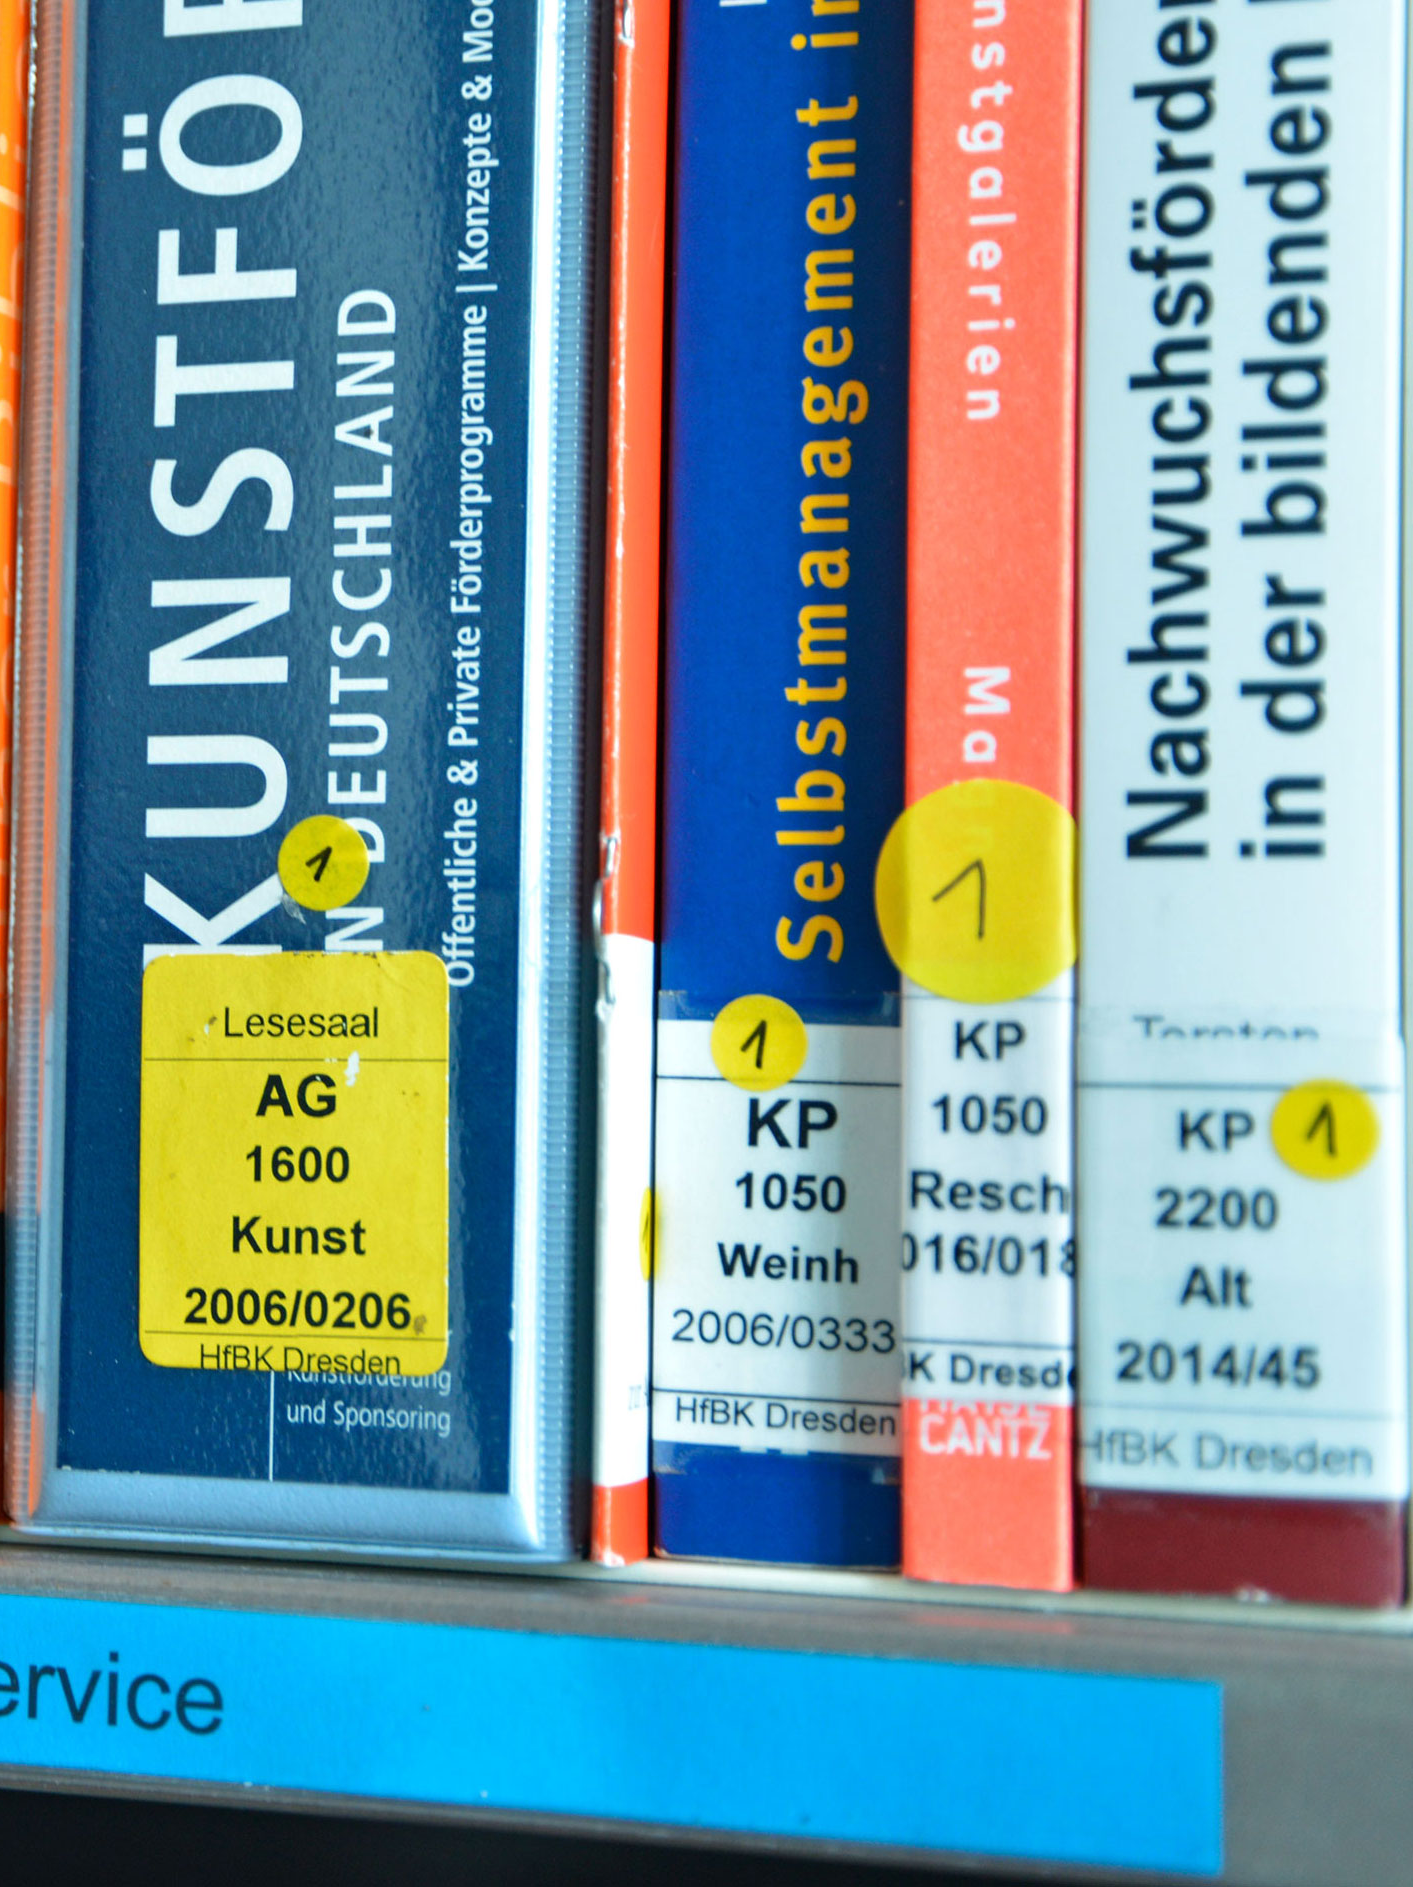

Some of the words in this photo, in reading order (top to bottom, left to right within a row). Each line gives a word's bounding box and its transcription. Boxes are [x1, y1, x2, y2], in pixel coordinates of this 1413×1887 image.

[461, 74, 493, 101] &
[457, 112, 498, 272] Konzepte
[1240, 39, 1333, 537] bildenden
[449, 305, 493, 614] Förderprogramme
[122, 0, 303, 968] KUNSTFÖ
[774, 95, 869, 964] Selbstmanagement
[1239, 572, 1327, 735] der
[447, 624, 482, 747] Private
[447, 759, 479, 786] &
[1239, 776, 1326, 860] in
[931, 857, 986, 941] 1
[324, 905, 385, 952] N
[224, 1006, 380, 1040] Lesesaal
[739, 1019, 768, 1070] 1
[954, 1020, 1027, 1061] KP
[255, 1072, 338, 1119] AG
[931, 1094, 1050, 1137] 1050
[748, 1098, 839, 1149] KP
[1177, 1109, 1255, 1152] KP
[1305, 1100, 1338, 1159] 1
[245, 1146, 351, 1184] 1600
[735, 1171, 847, 1213] 1050
[910, 1169, 1070, 1214] Resch
[1154, 1186, 1280, 1231] 2200
[231, 1215, 367, 1257] Kunst
[717, 1242, 859, 1285] Weinh
[1179, 1265, 1254, 1308] Alt
[184, 1287, 413, 1331] 2006/0206
[671, 1308, 897, 1354] 2006/0333
[199, 1344, 275, 1372] HfBK
[283, 1346, 402, 1375] Dresden
[1115, 1340, 1322, 1390] 2014/45
[287, 1398, 327, 1425] und
[333, 1399, 452, 1438] Sponsoring
[675, 1396, 756, 1428] HfBK
[765, 1402, 897, 1436] Dresden
[919, 1413, 1053, 1460] CANTZ
[1080, 1429, 1180, 1469] HfBK
[1195, 1433, 1373, 1478] Dresden
